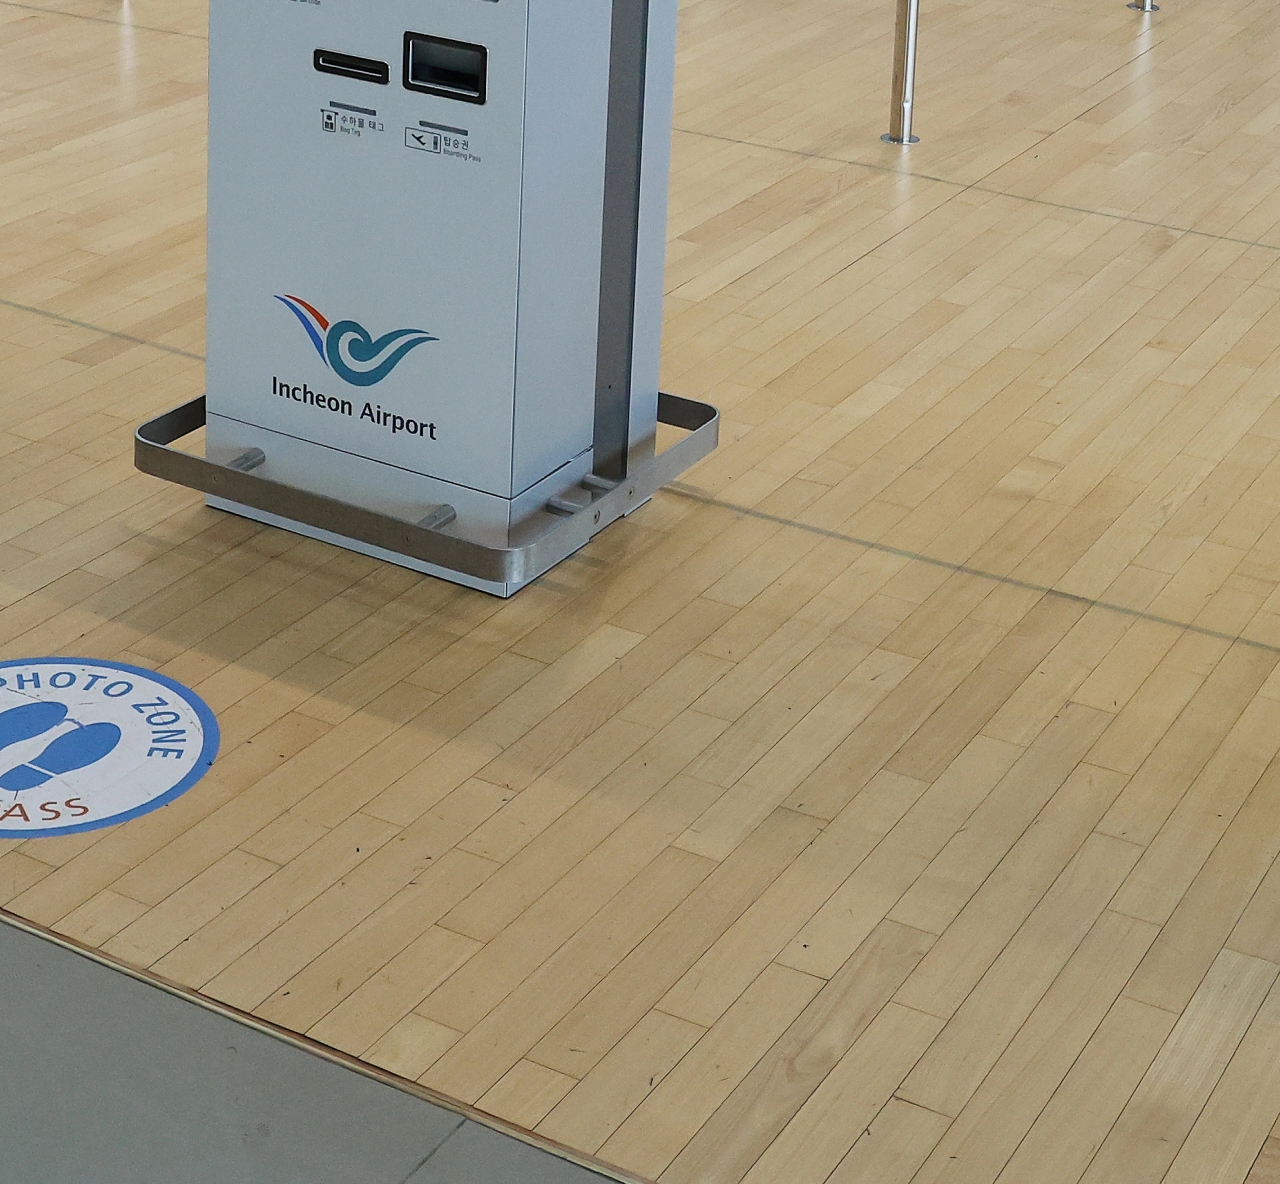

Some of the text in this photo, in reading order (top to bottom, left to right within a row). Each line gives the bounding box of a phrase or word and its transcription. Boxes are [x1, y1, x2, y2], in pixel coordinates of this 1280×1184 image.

[272, 376, 437, 441] Incheon Airport
[131, 696, 187, 760] ZONE
